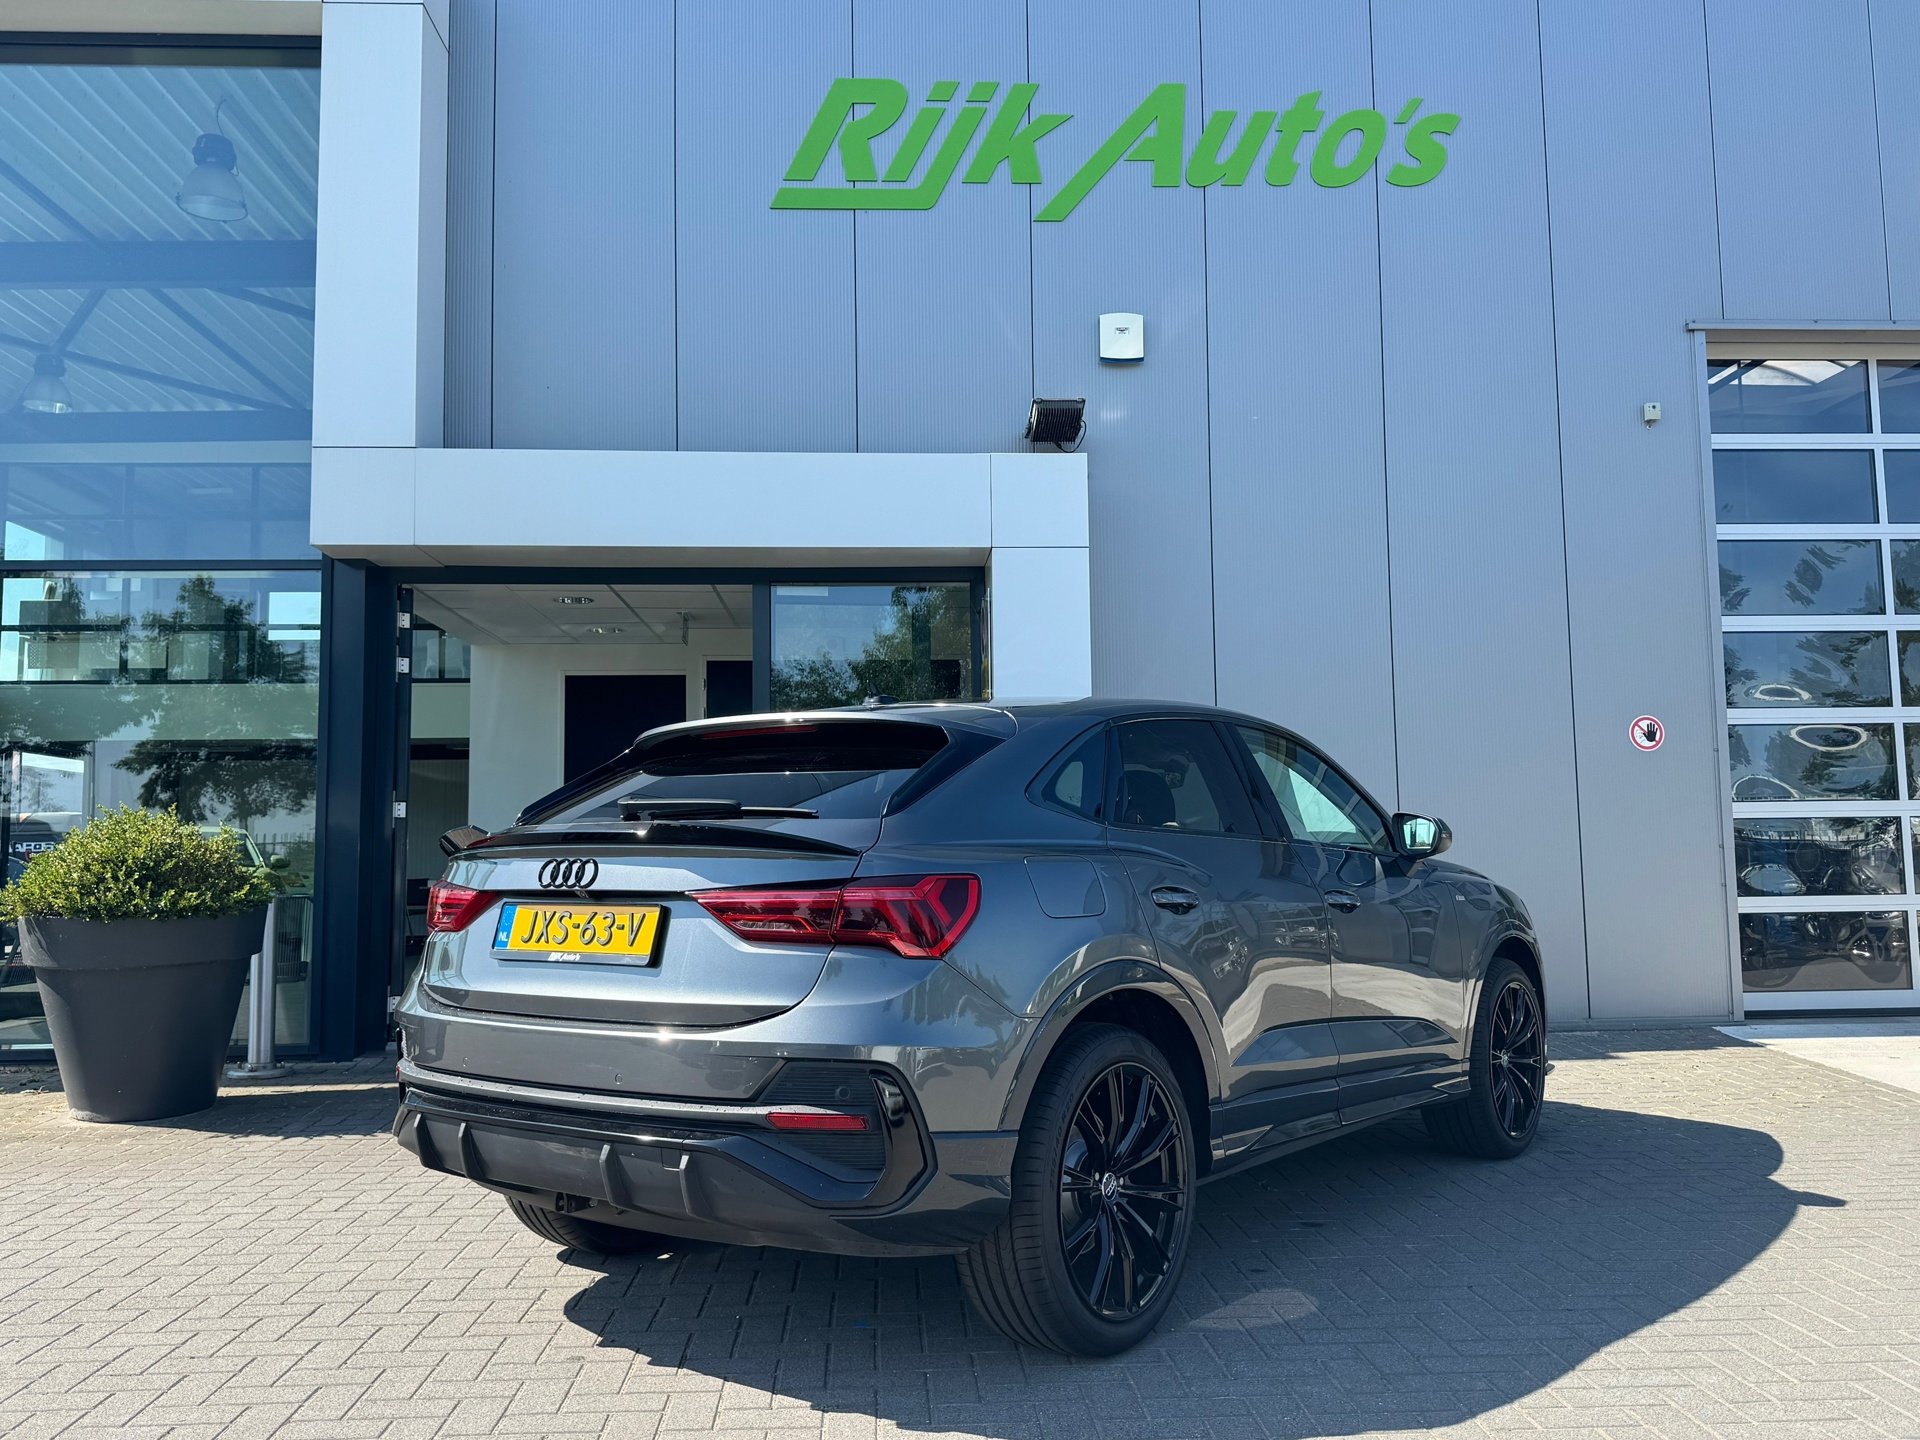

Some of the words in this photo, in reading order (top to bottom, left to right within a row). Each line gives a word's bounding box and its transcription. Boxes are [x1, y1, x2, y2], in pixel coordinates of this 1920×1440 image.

[770, 77, 1074, 211] Rijk
[1033, 82, 1462, 222] Auto's
[498, 931, 508, 942] NL
[520, 910, 646, 947] JXS-63-V
